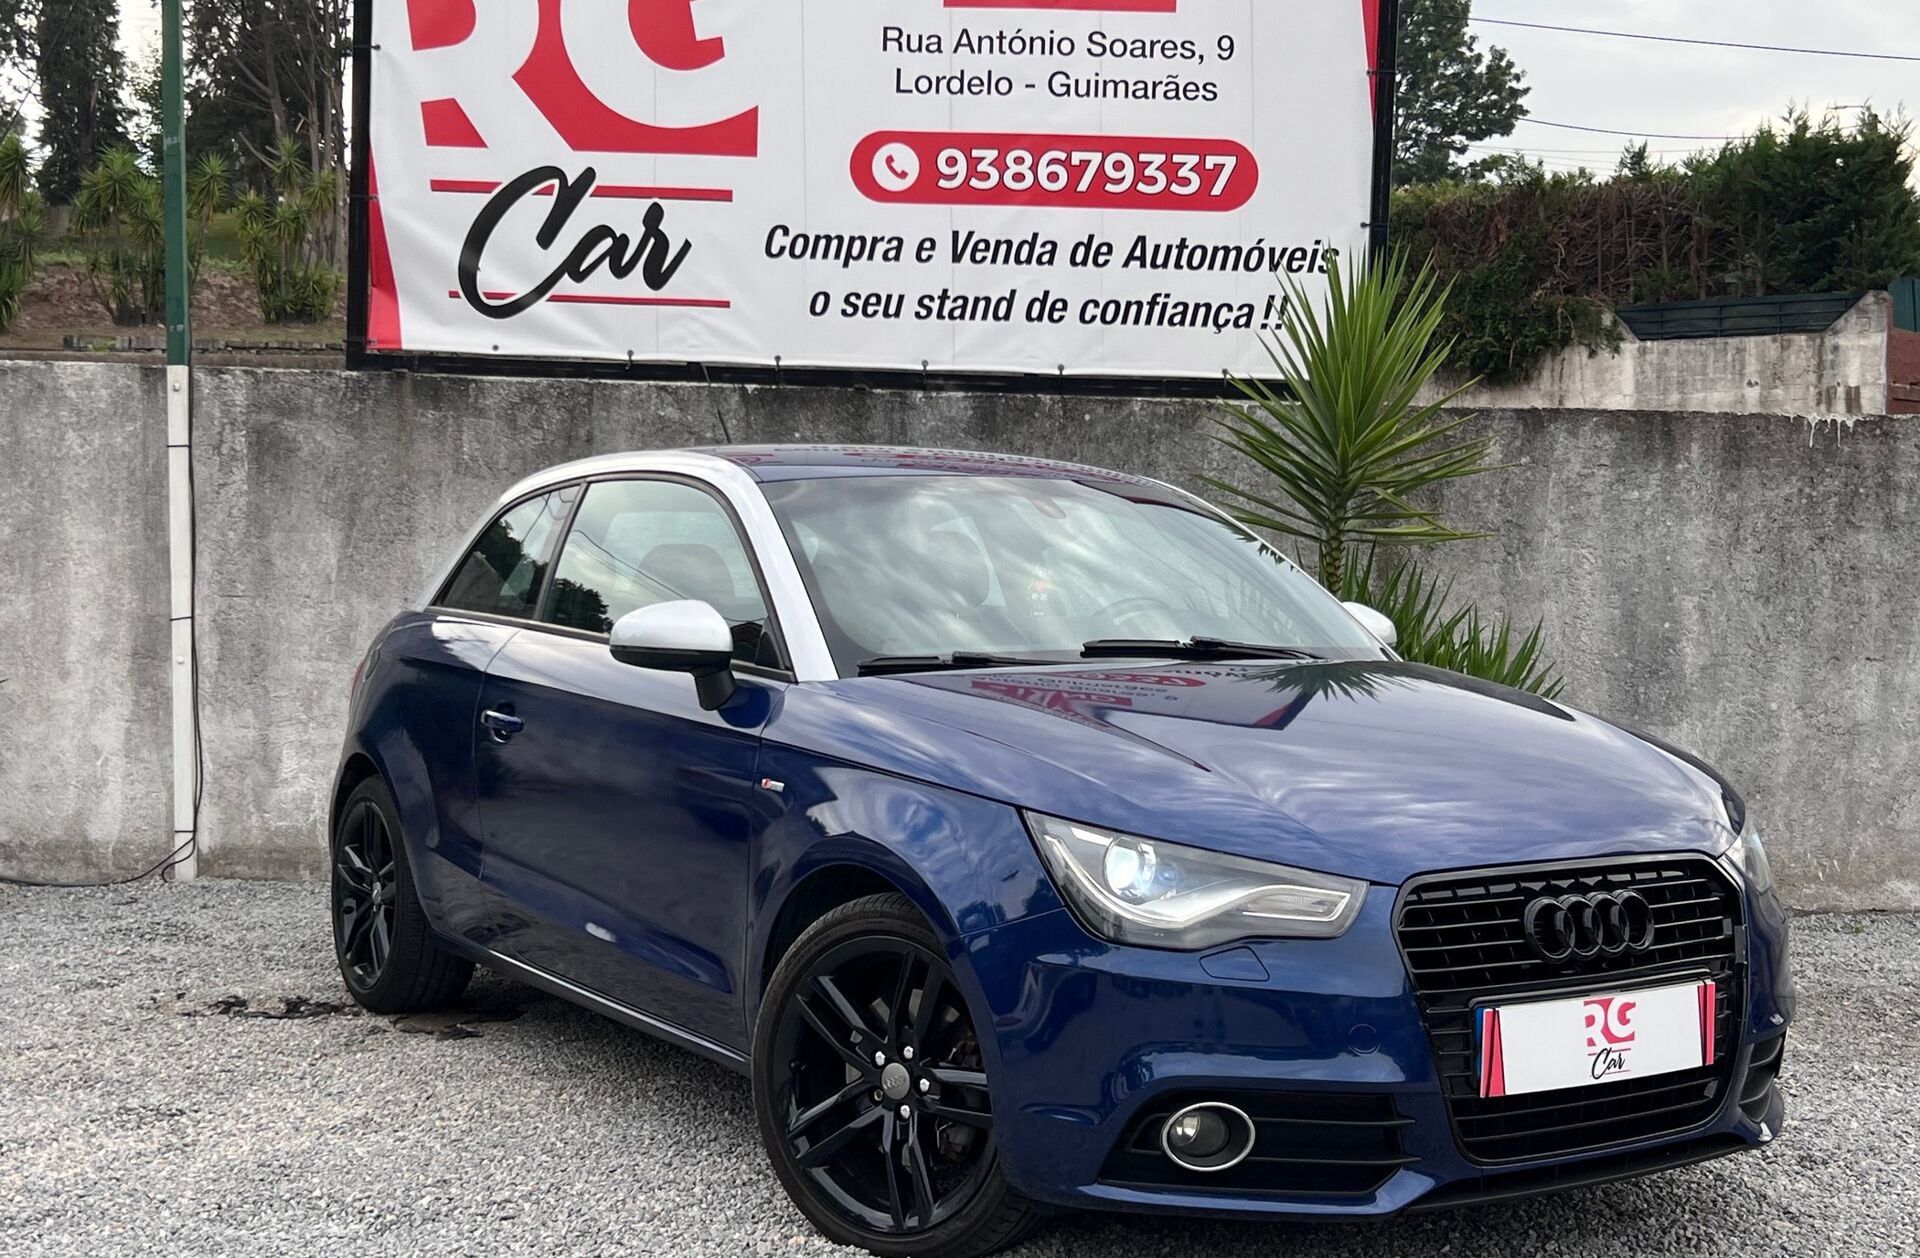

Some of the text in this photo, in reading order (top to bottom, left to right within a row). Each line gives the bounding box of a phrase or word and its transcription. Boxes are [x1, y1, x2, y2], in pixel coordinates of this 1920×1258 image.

[882, 26, 1235, 64] Rua António Soares, 9
[895, 67, 1013, 96] Lordelo
[1047, 71, 1218, 103] Guimarães
[935, 147, 1238, 197] 938679337
[458, 165, 692, 319] Car
[764, 224, 1340, 275] Compra e Venda de Automóveis
[809, 291, 831, 317] o
[840, 292, 905, 319] seu
[914, 288, 1017, 322] stand
[1025, 289, 1070, 324] de
[1078, 293, 1255, 334] confiança
[1591, 1046, 1626, 1080] Car
